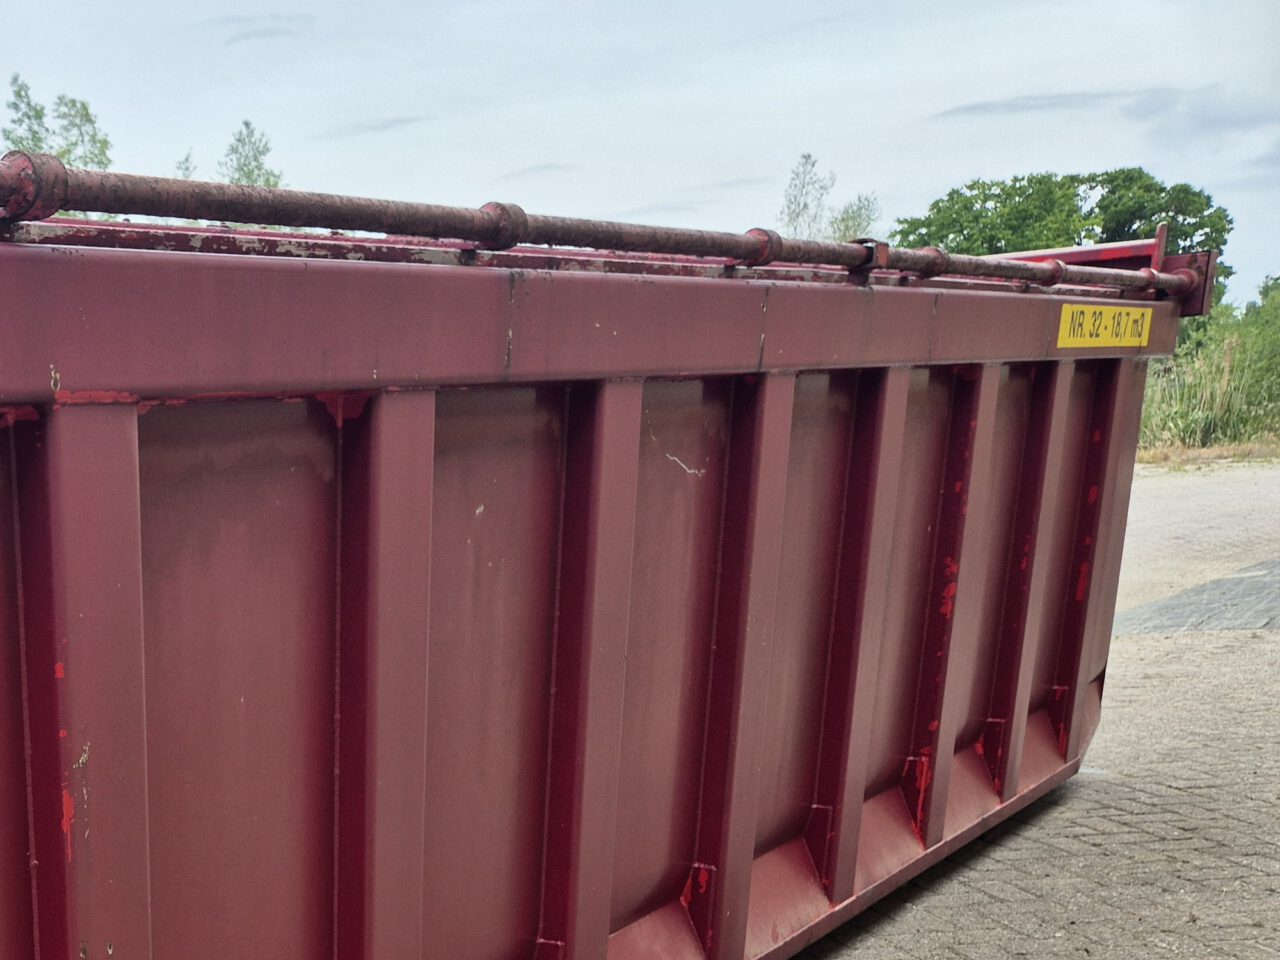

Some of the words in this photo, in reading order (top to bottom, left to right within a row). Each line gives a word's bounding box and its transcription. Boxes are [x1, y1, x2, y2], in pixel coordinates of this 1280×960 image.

[1068, 310, 1086, 338] NR.
[1089, 310, 1103, 338] 32
[1110, 311, 1131, 341] 18,7
[1130, 312, 1145, 338] m3
